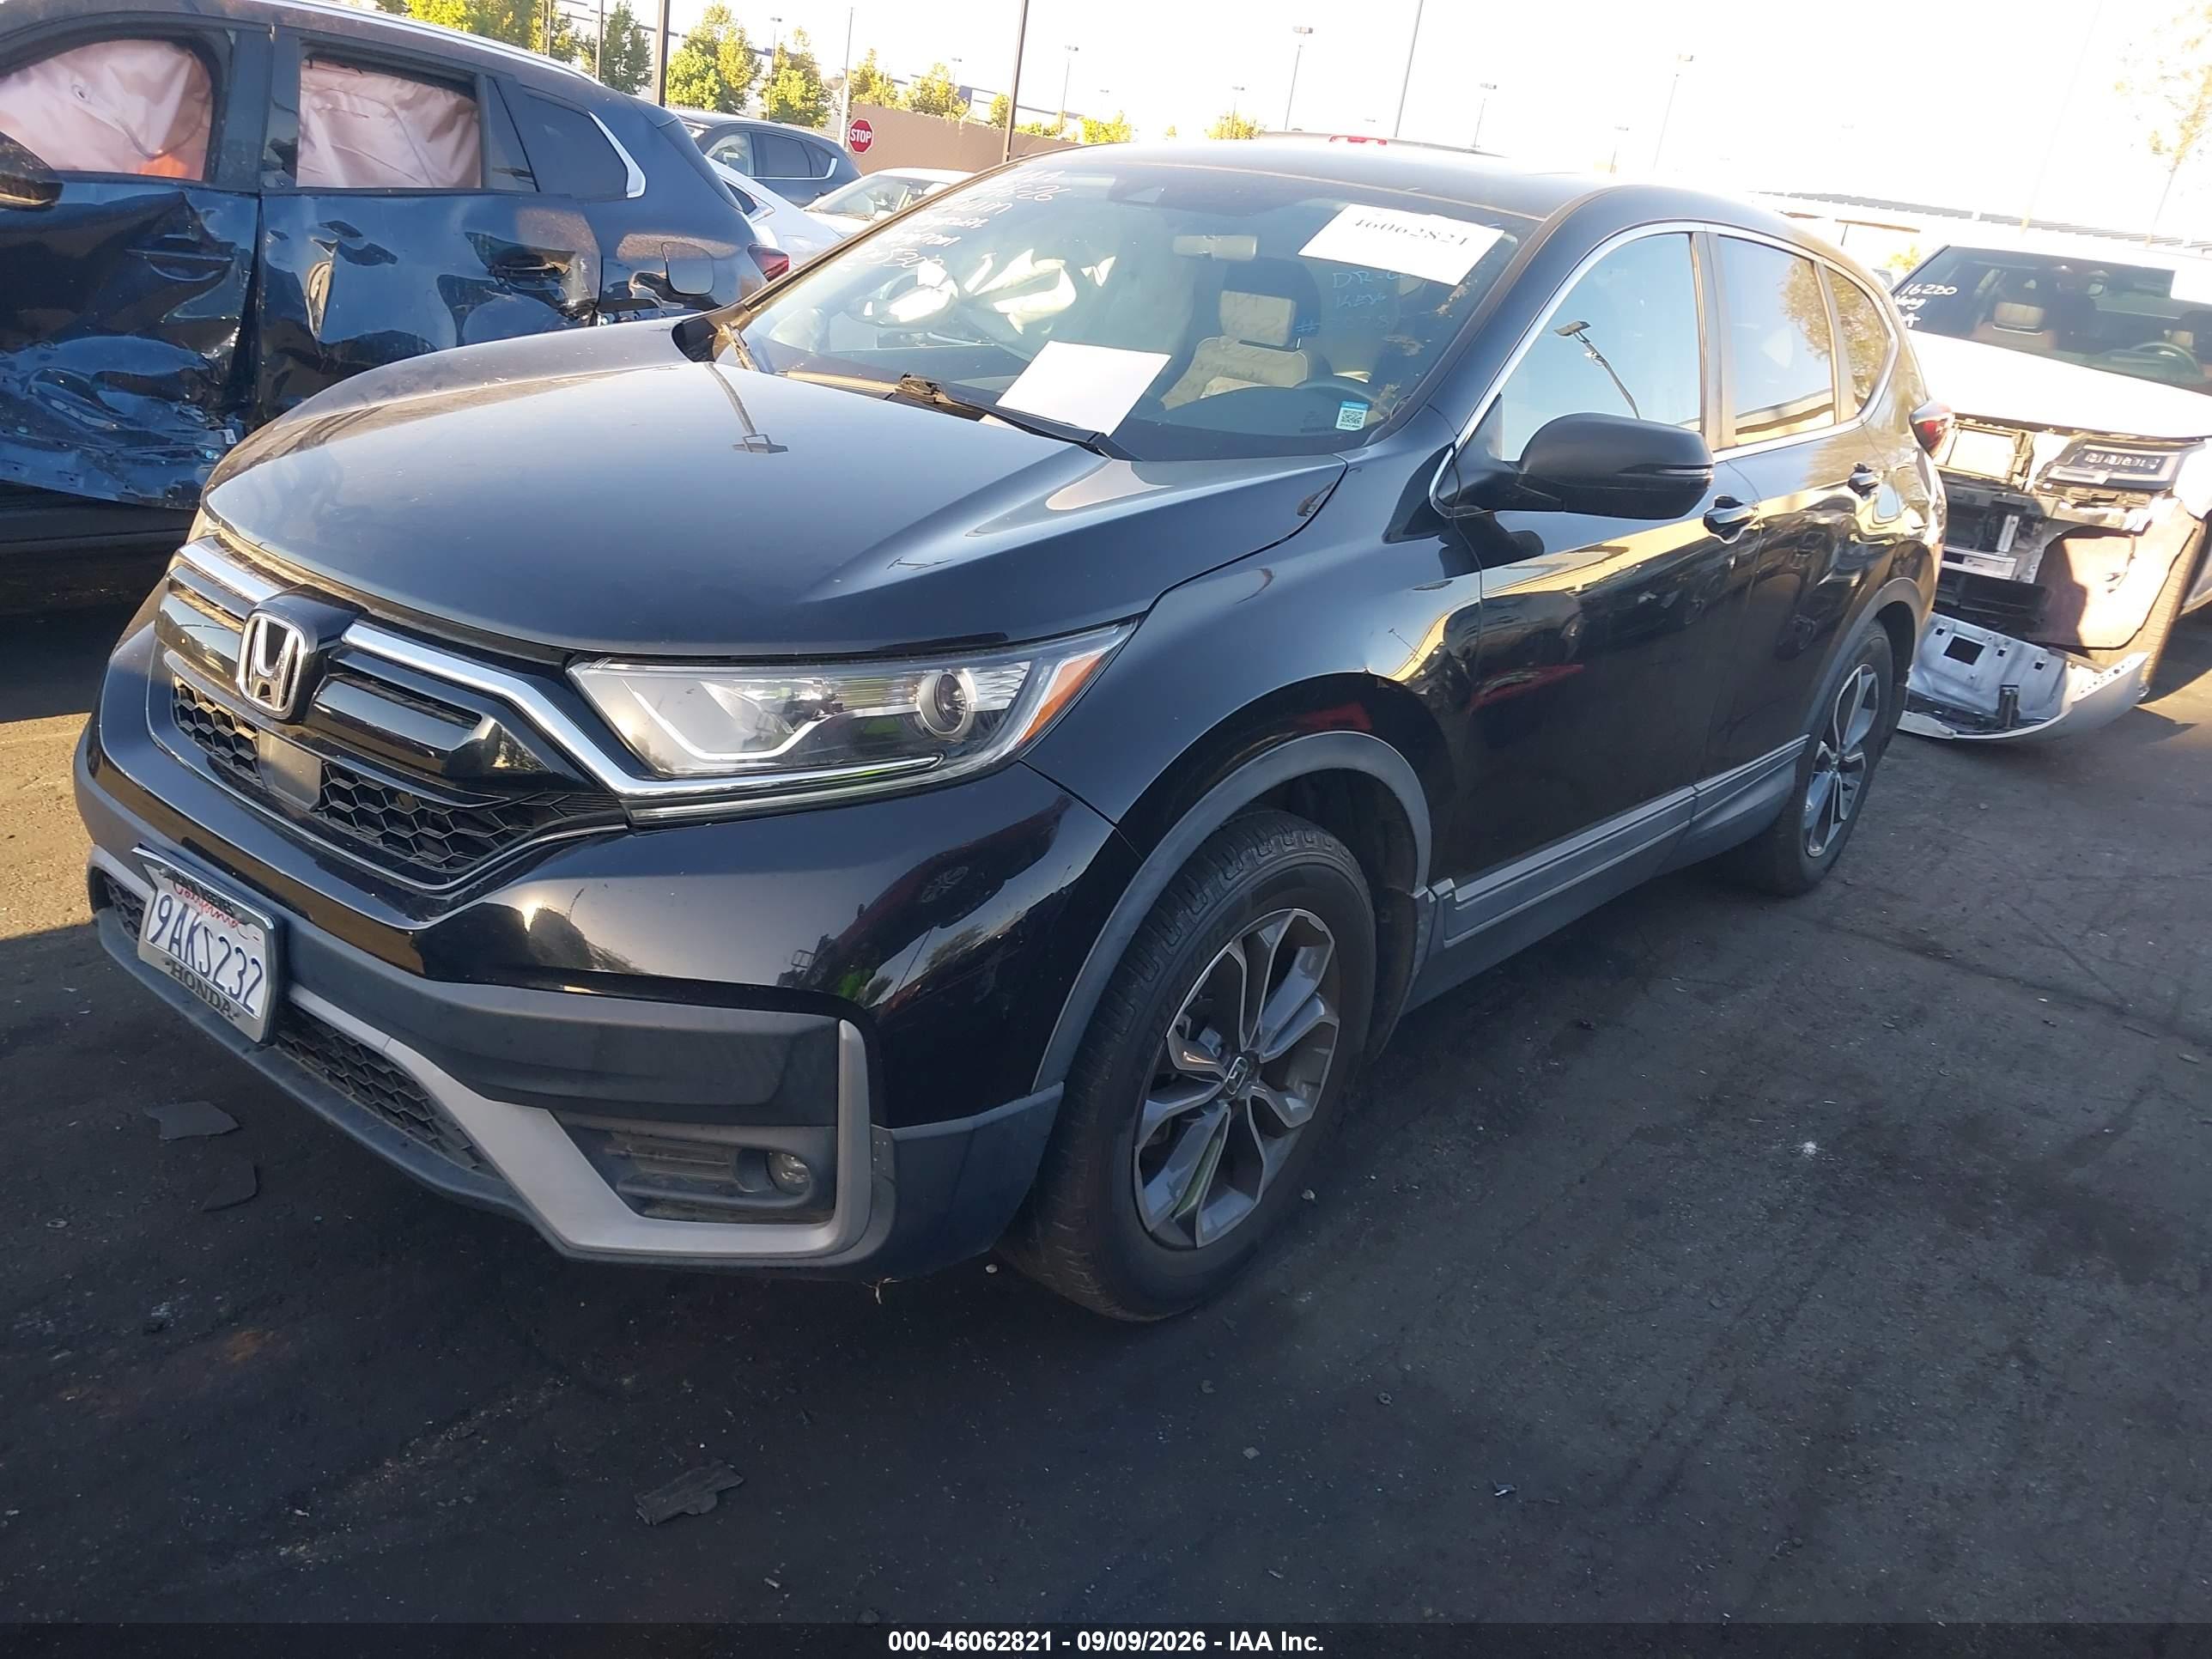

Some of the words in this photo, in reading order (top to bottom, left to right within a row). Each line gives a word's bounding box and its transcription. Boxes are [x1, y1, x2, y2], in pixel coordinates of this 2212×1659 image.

[850, 129, 872, 143] STOP
[149, 895, 263, 1014] 9AKS232
[170, 961, 236, 1020] HONDA
